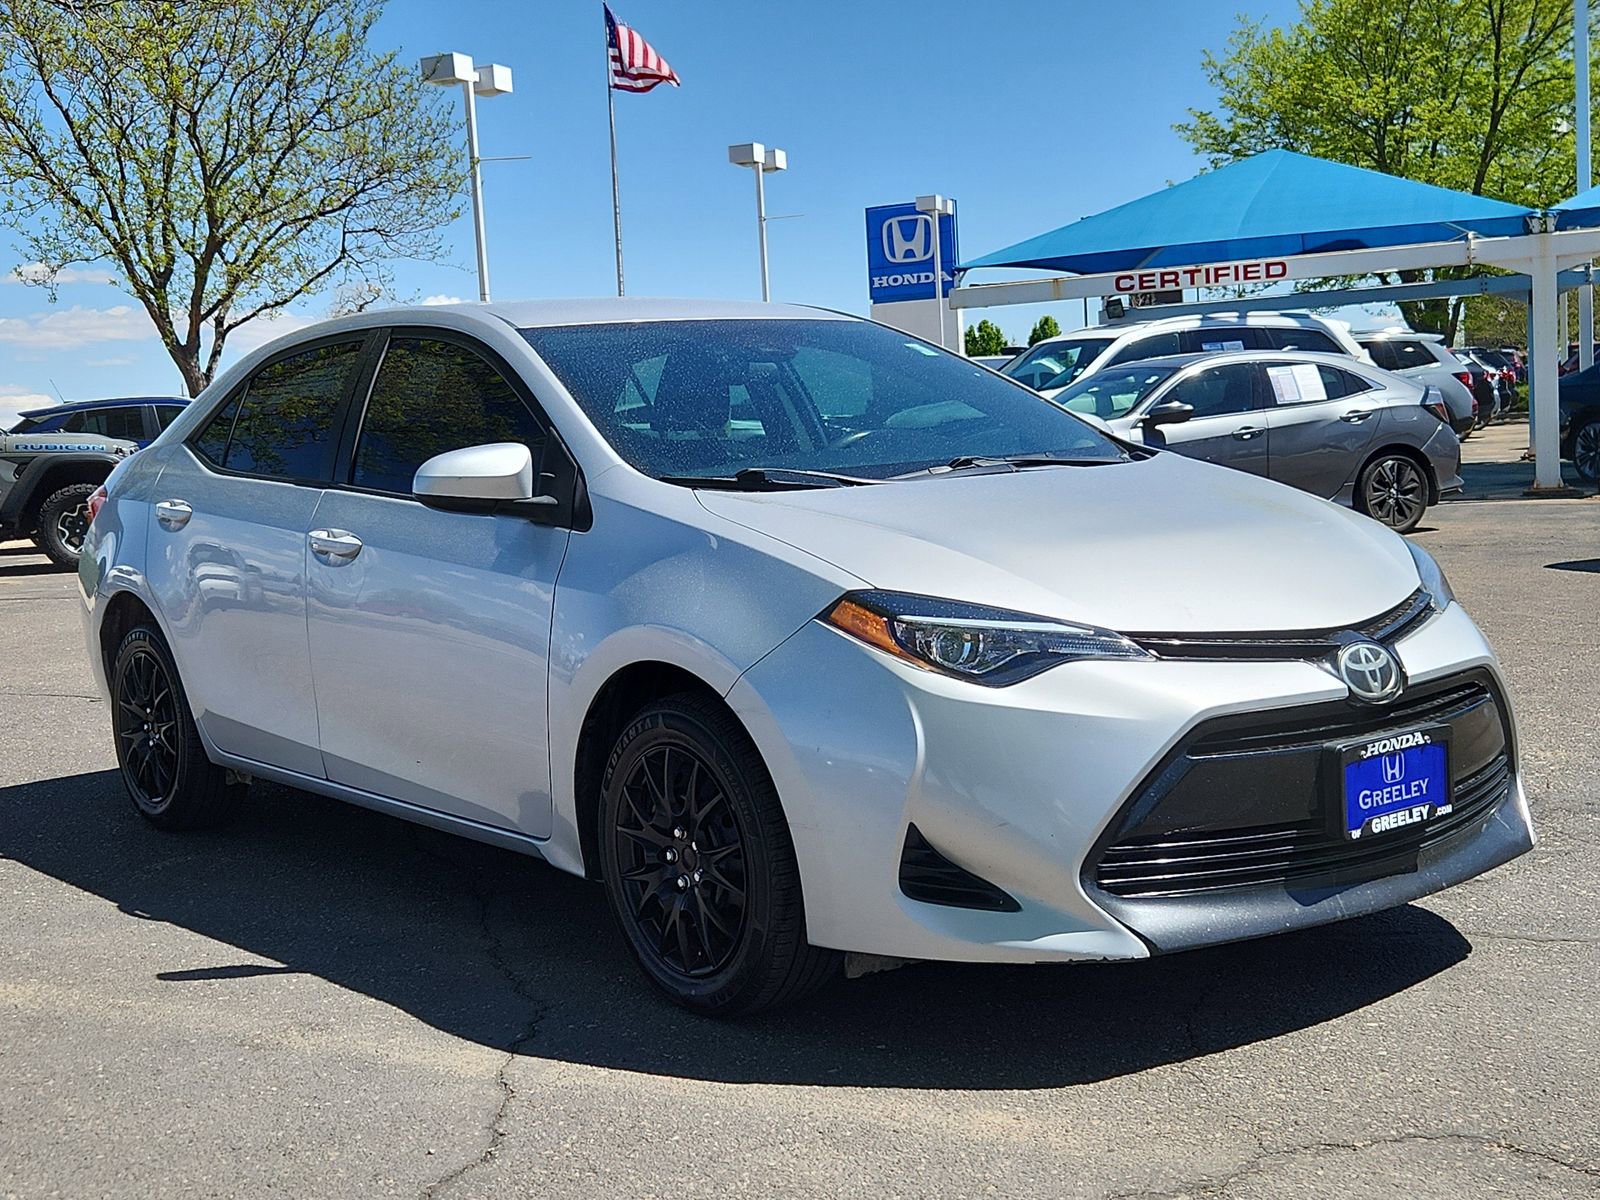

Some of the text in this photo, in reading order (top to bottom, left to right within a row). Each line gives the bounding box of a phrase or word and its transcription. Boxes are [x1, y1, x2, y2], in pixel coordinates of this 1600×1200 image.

[872, 271, 953, 288] HONDA
[1114, 261, 1287, 292] CERTIFIED
[14, 443, 105, 451] RUBICON
[1366, 732, 1425, 758] HONDA
[1359, 778, 1430, 810] GREELEY
[1371, 804, 1429, 833] GREELEY
